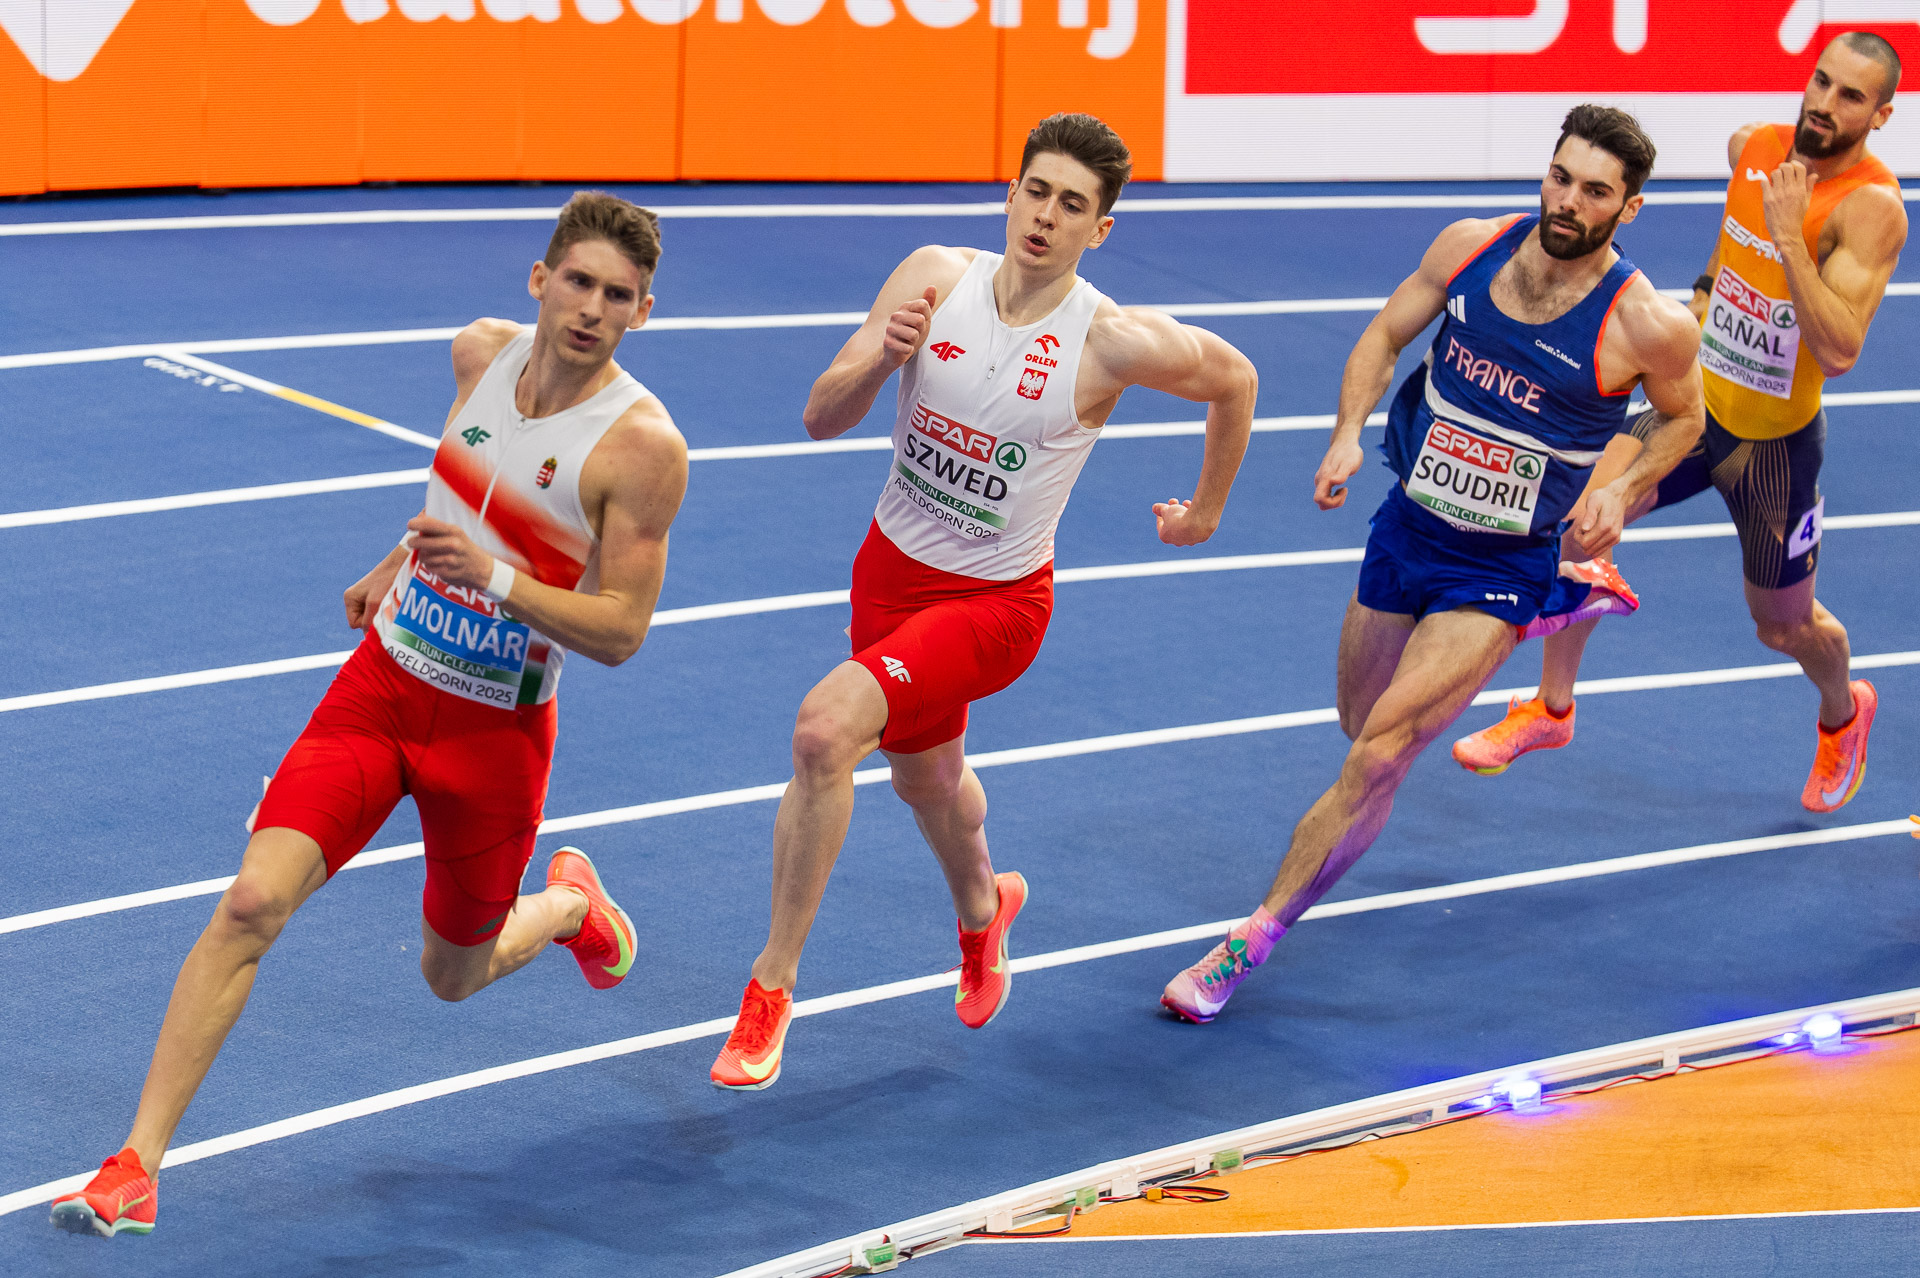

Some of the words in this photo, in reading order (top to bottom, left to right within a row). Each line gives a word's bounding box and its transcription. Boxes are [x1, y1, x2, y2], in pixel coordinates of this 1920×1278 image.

[1718, 273, 1769, 320] SPAR
[1713, 305, 1785, 358] CAÑAL
[929, 341, 966, 362] 4F
[1025, 354, 1057, 368] ORLEN
[1732, 352, 1765, 372] CLEAN
[1444, 336, 1546, 413] FRANCE
[1757, 376, 1786, 392] 2025
[461, 426, 492, 447] 4F
[911, 411, 992, 459] SPAR
[1430, 425, 1511, 470] SPAR
[904, 433, 1007, 501] SZWED
[1415, 455, 1531, 512] SOUDRIL
[894, 477, 964, 530] APELDOORN
[916, 477, 939, 498] RUN
[1435, 500, 1460, 517] RUN
[1800, 512, 1815, 541] 4
[402, 586, 523, 661] MOLNÁR
[420, 642, 442, 662] RUN
[881, 655, 912, 684] 4F
[386, 645, 472, 693] APELDOORN
[475, 684, 513, 703] 2025
